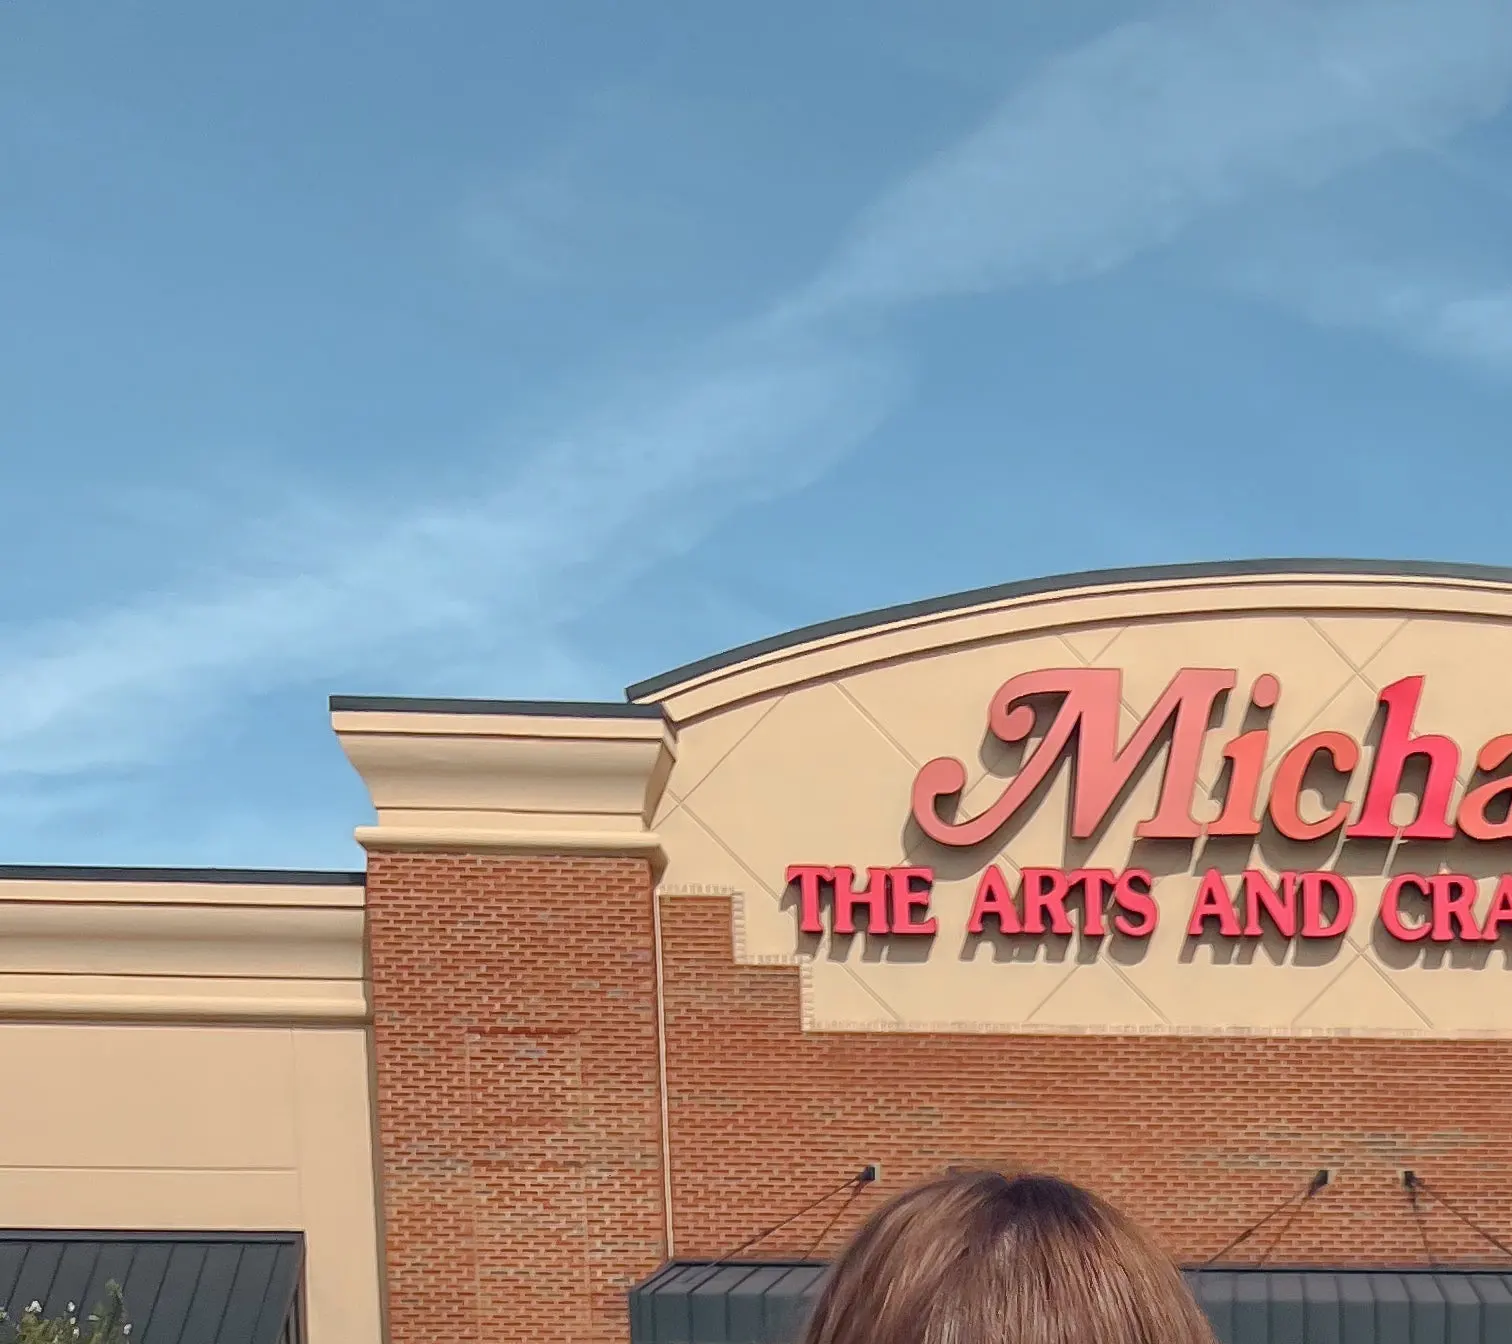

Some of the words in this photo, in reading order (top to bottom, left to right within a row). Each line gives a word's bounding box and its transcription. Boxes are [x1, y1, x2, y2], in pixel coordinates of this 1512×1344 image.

[786, 864, 937, 934] THE
[967, 864, 1159, 937] ARTS
[1187, 867, 1354, 938] AND
